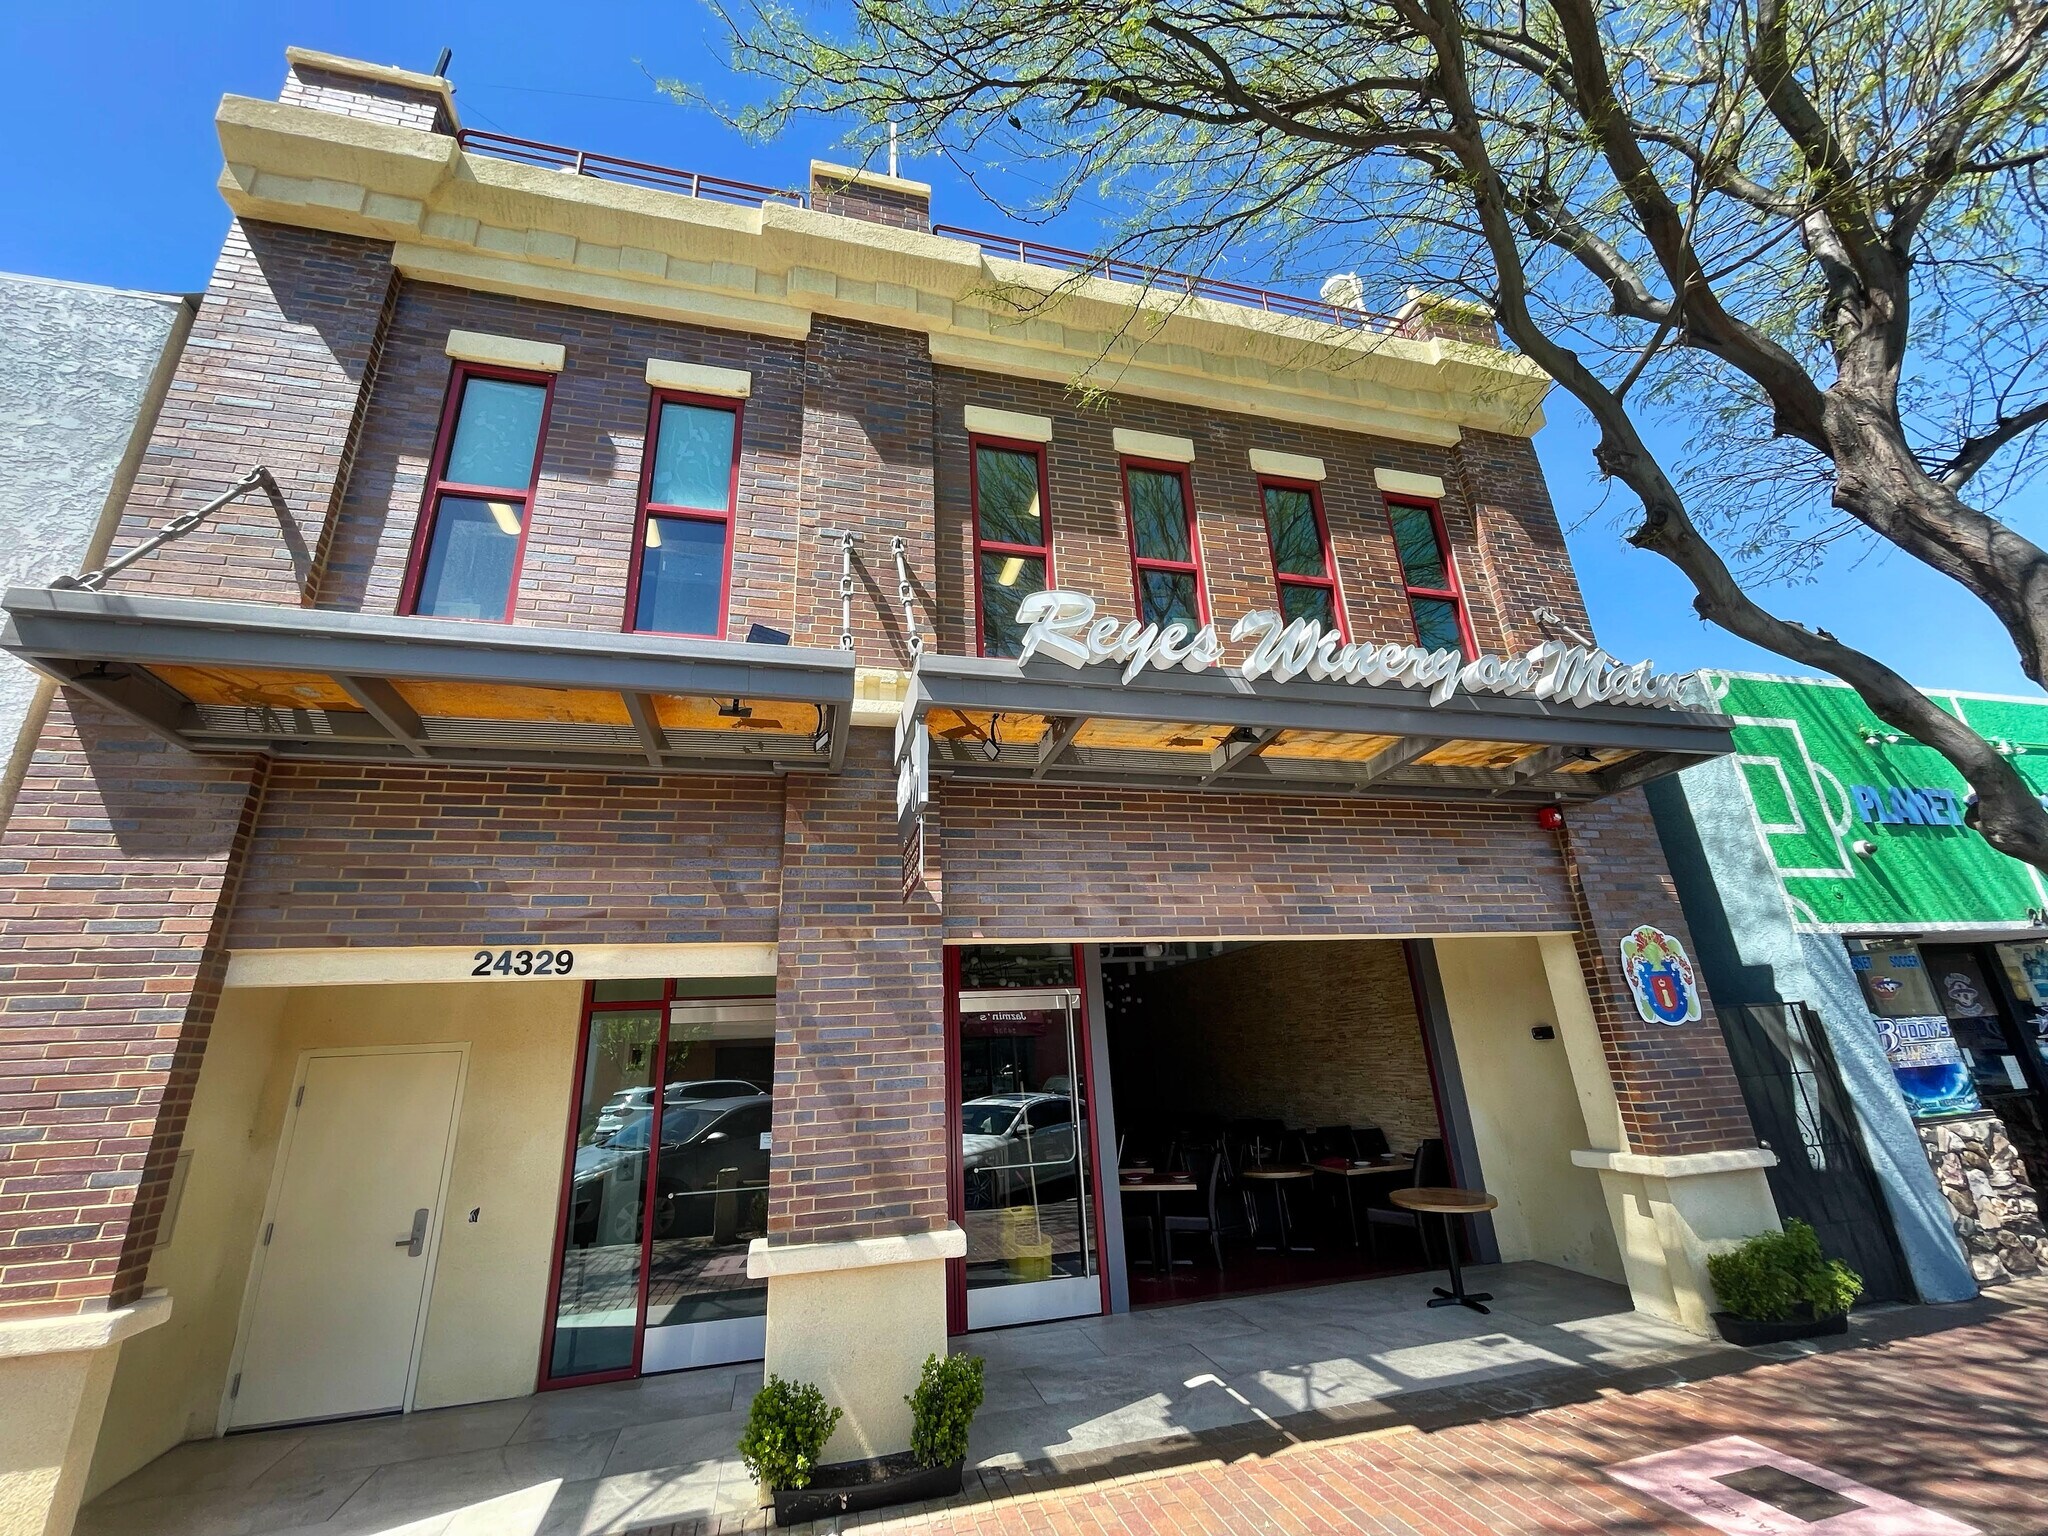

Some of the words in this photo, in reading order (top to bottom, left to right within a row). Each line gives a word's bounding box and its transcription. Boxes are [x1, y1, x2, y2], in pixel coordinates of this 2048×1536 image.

[1017, 591, 1223, 685] Reyes
[1232, 609, 1468, 707] Winery
[1465, 654, 1538, 694] on
[1538, 640, 1686, 708] Main
[1850, 784, 1964, 825] PLANET
[473, 951, 574, 976] 24329
[1889, 954, 1921, 968] SOCCER
